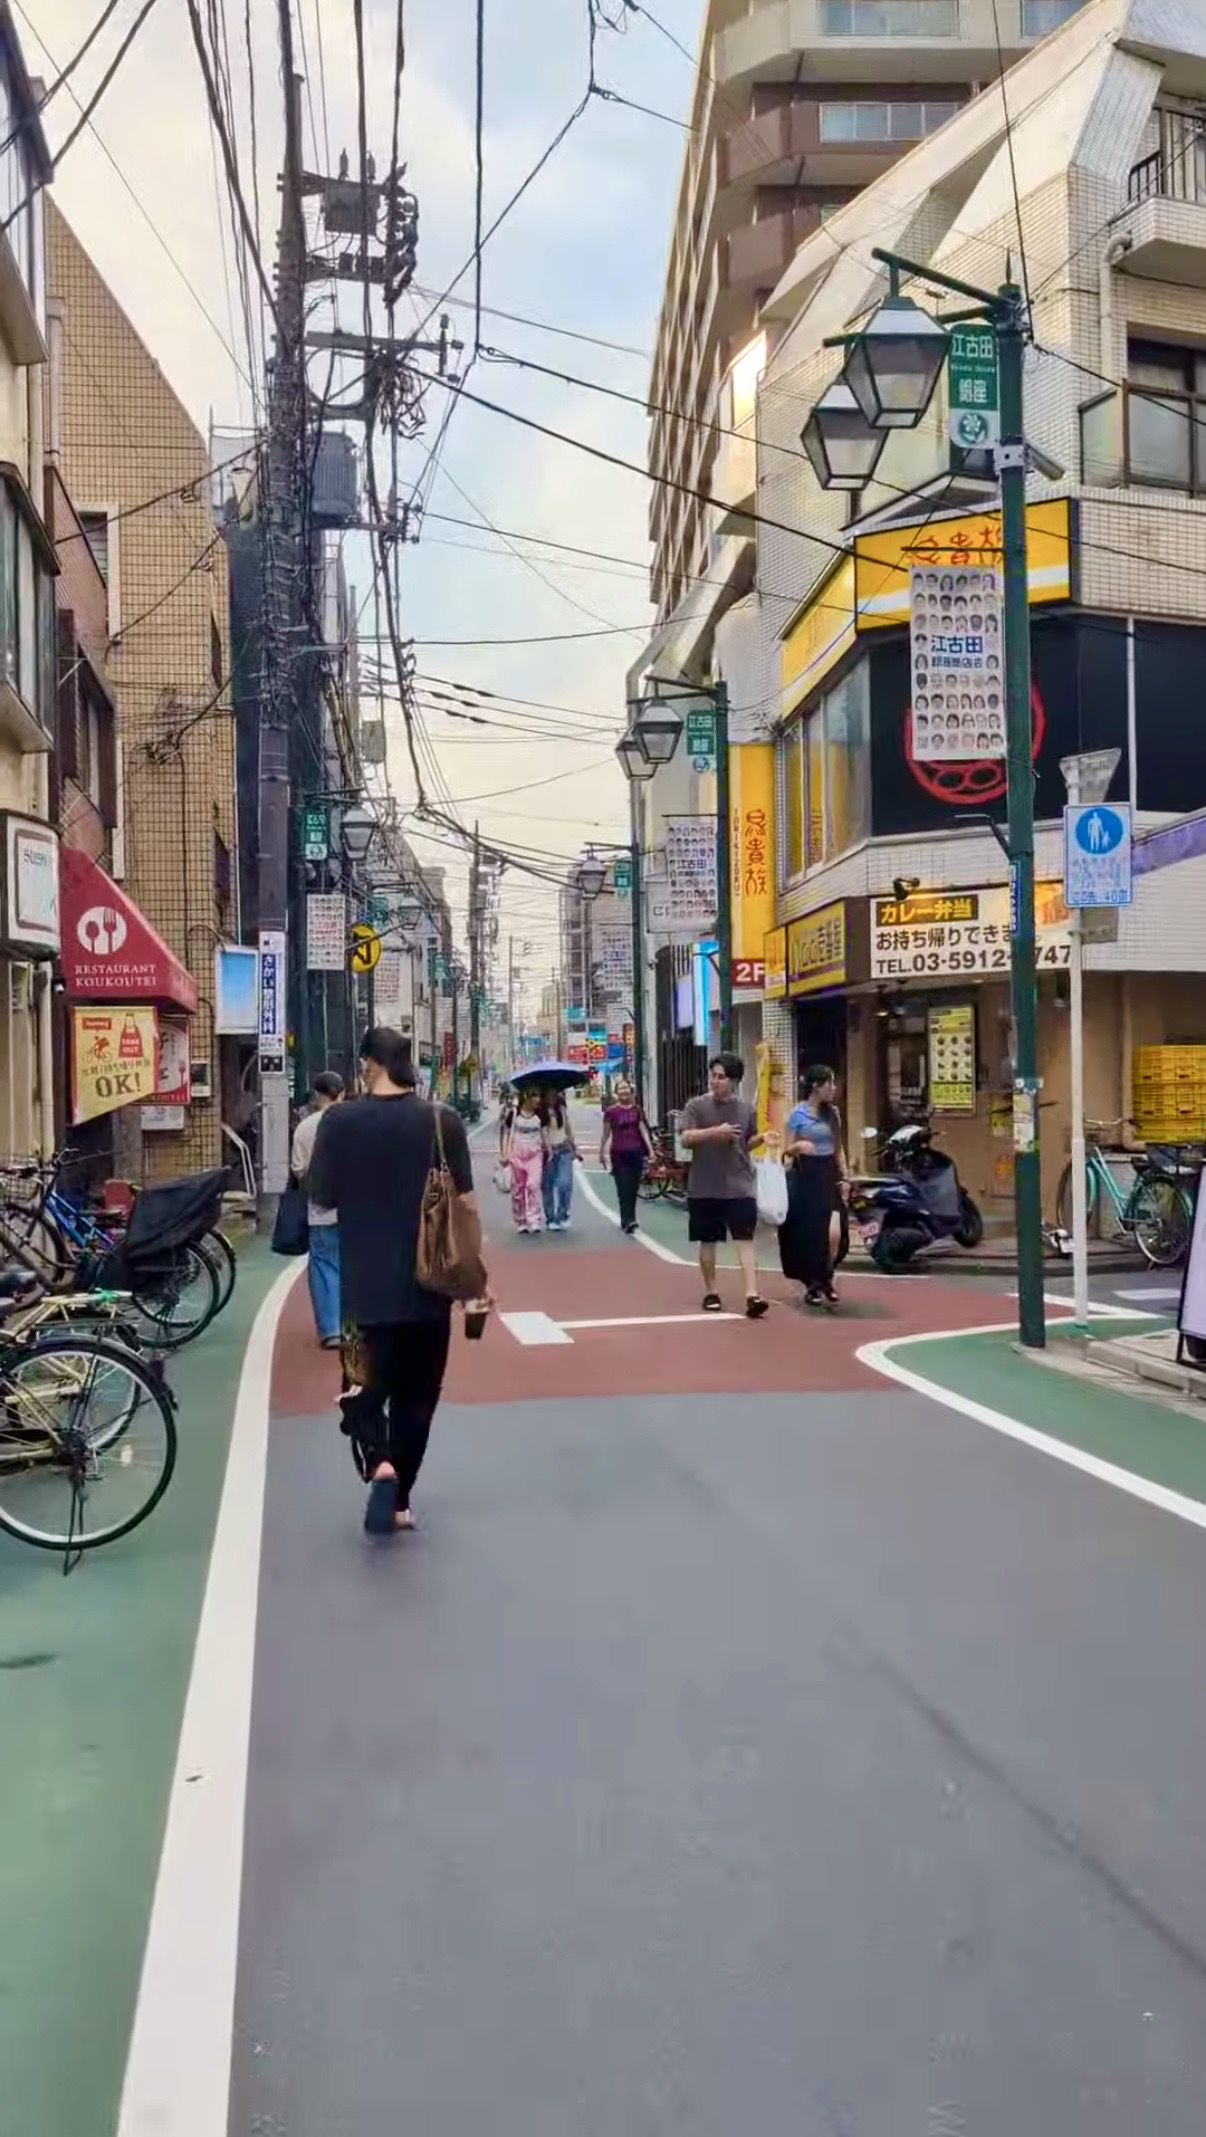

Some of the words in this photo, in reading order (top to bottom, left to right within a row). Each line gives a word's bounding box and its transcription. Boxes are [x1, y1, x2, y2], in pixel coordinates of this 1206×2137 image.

[951, 333, 993, 358] 江古田
[931, 635, 984, 654] 江古田
[880, 898, 973, 924] カレー弁当
[75, 964, 156, 976] RESTAURANT
[736, 962, 765, 982] 2F
[75, 975, 157, 988] KOUKOUTEI
[95, 1072, 141, 1099] OK!
